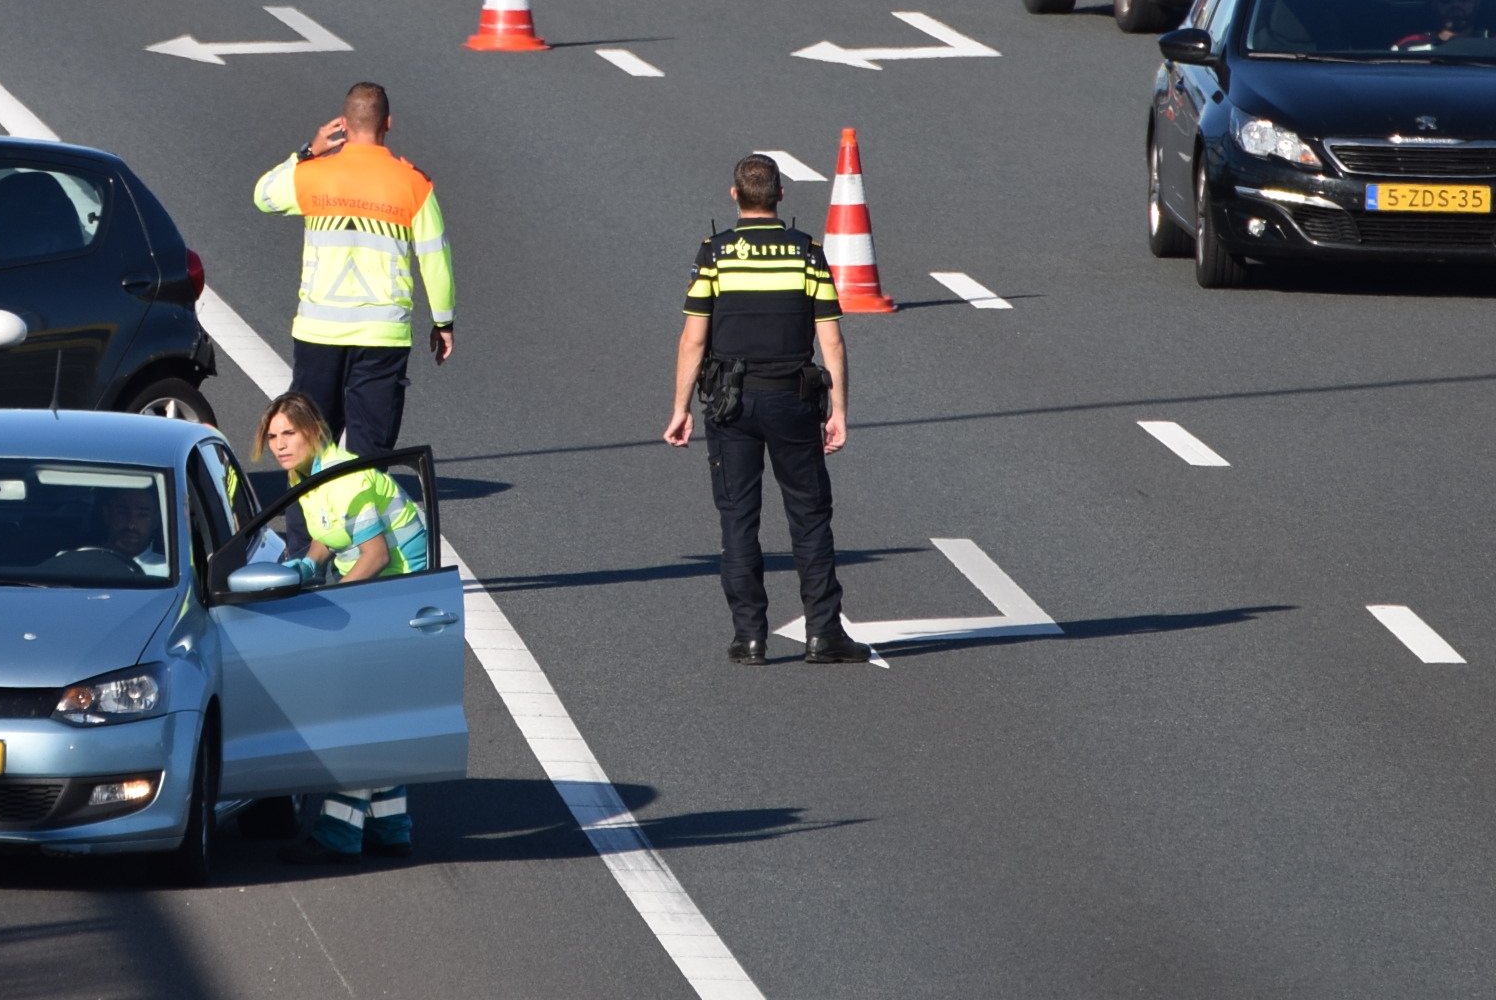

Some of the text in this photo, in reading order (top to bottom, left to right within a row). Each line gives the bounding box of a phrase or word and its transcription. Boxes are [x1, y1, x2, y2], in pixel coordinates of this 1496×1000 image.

[310, 193, 406, 218] Rijkswaterstaat
[1387, 188, 1484, 208] 5-ZDS-35
[725, 239, 796, 259] POLITIE
